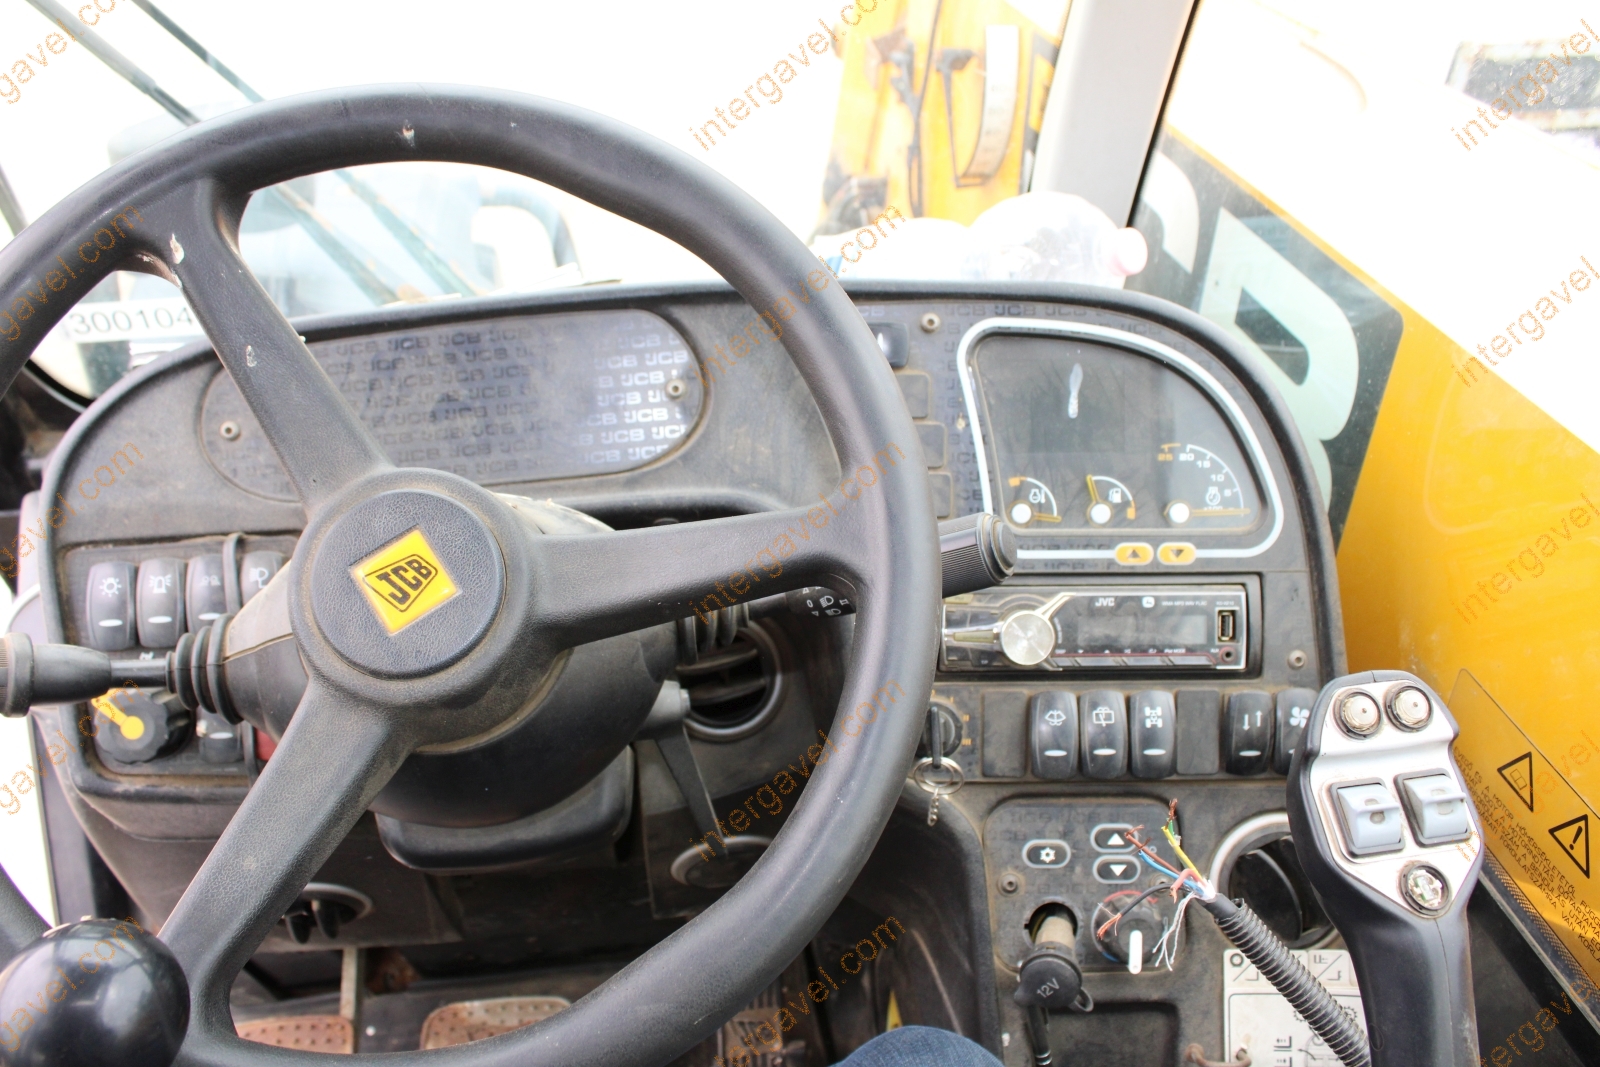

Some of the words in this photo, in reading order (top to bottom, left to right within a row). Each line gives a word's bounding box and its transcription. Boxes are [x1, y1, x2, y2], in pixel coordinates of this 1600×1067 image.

[645, 351, 688, 366] JCB
[620, 371, 666, 387] JCB
[597, 391, 642, 407] JCB
[624, 408, 669, 424] JCB
[601, 428, 645, 444] JCB
[1179, 453, 1195, 461] 20
[1196, 460, 1211, 468] 15
[1210, 474, 1225, 482] 10
[375, 559, 432, 605] JCB
[1095, 597, 1115, 607] JVC
[1490, 793, 1514, 821] MOTOR
[1514, 821, 1579, 899] HŐMÉRSÉKLETÉTŐL
[1578, 898, 1600, 929] FÜGG
[1558, 910, 1577, 931] VAN
[1566, 908, 1590, 935] UTÁN
[1036, 977, 1060, 999] 12V
